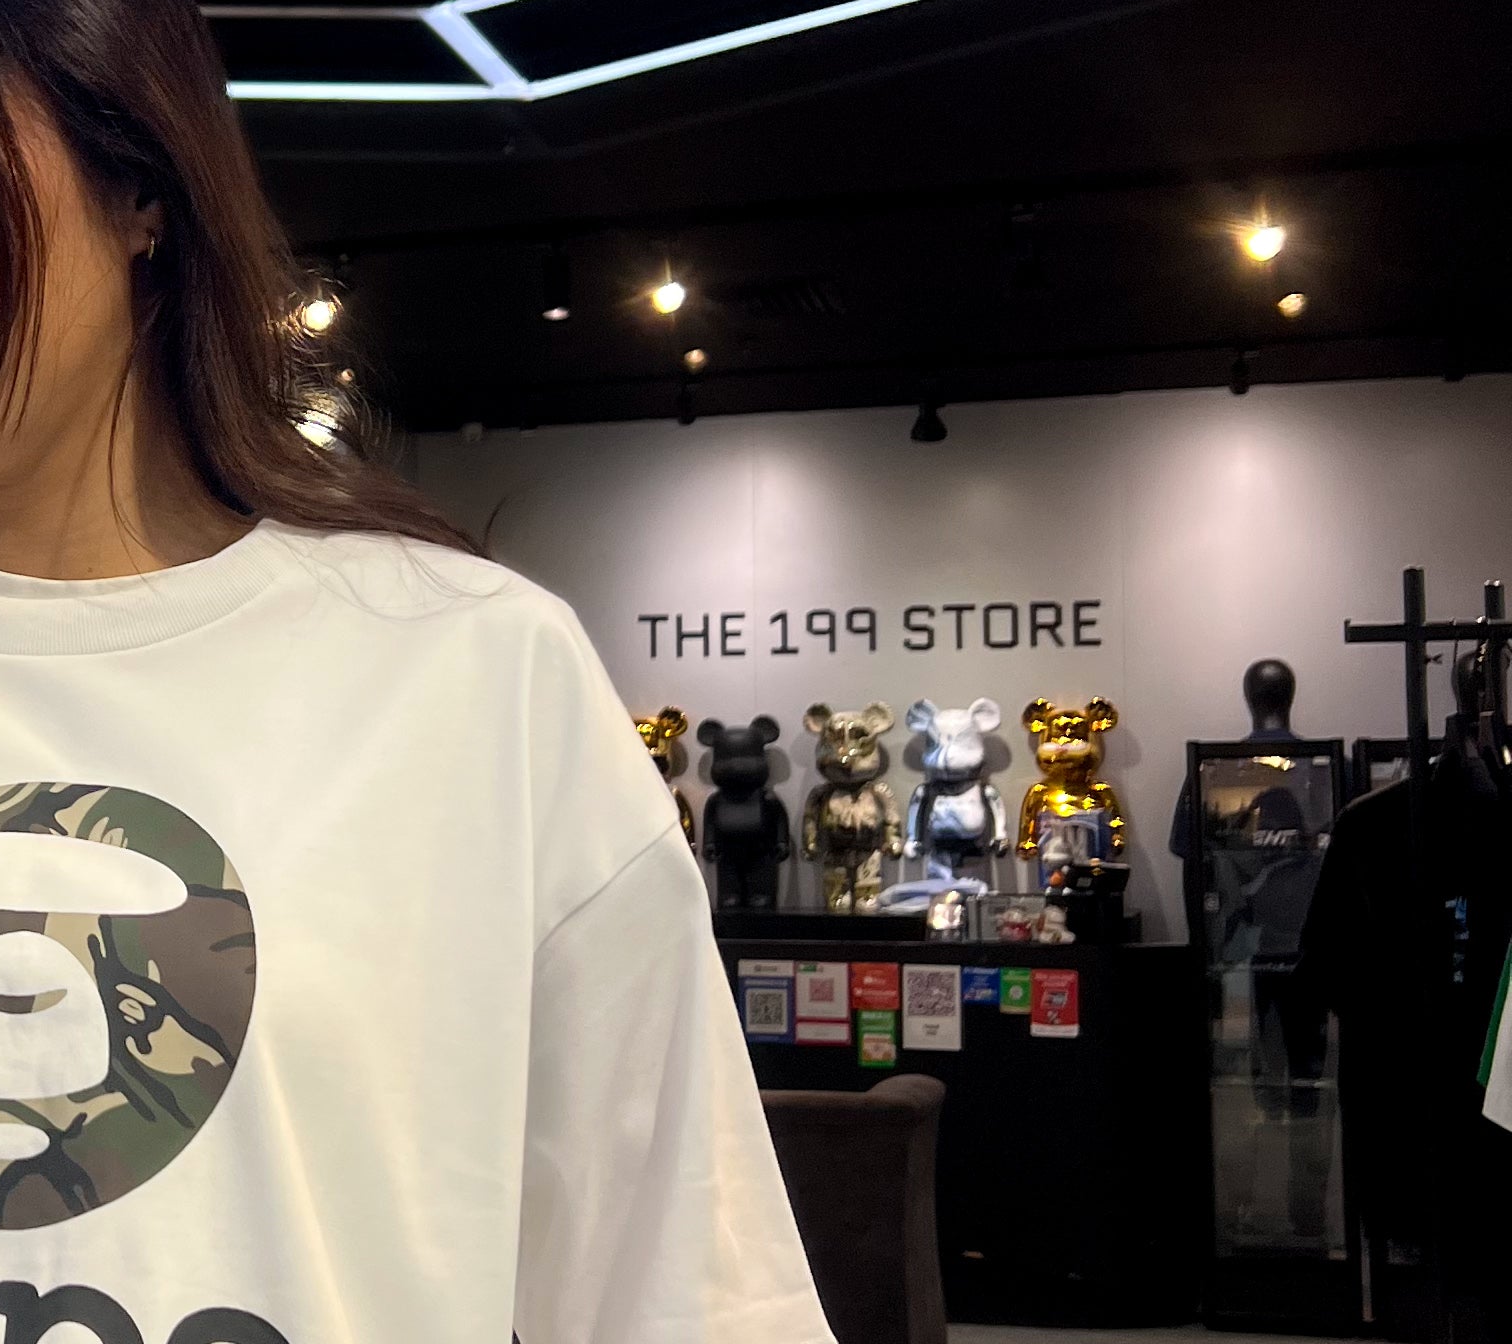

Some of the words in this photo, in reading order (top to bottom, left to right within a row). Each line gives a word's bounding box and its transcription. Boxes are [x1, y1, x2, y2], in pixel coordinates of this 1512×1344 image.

[638, 611, 746, 658] THE
[769, 606, 877, 656] 199
[903, 599, 1103, 651] STORE
